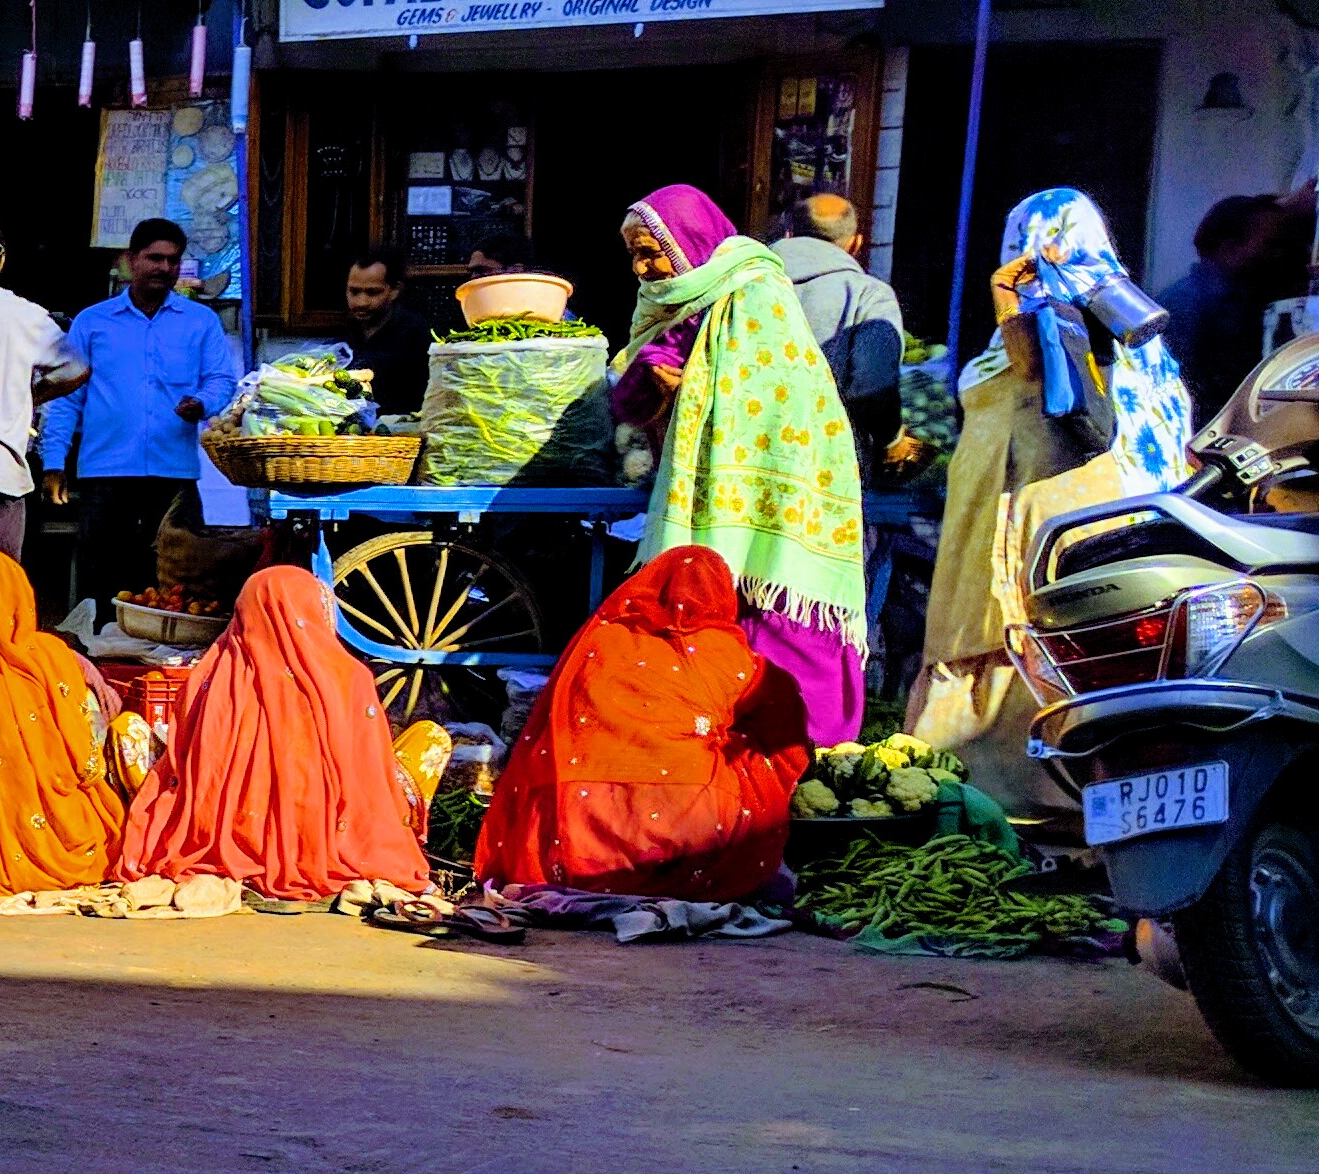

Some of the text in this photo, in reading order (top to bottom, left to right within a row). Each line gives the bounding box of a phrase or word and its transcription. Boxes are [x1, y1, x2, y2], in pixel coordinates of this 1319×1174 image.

[397, 7, 445, 26] GEMS
[461, 2, 543, 24] JEWELLRY
[562, 0, 640, 17] ORIGINAL
[650, 0, 711, 11] DESIGN
[1121, 796, 1206, 835] S6476
